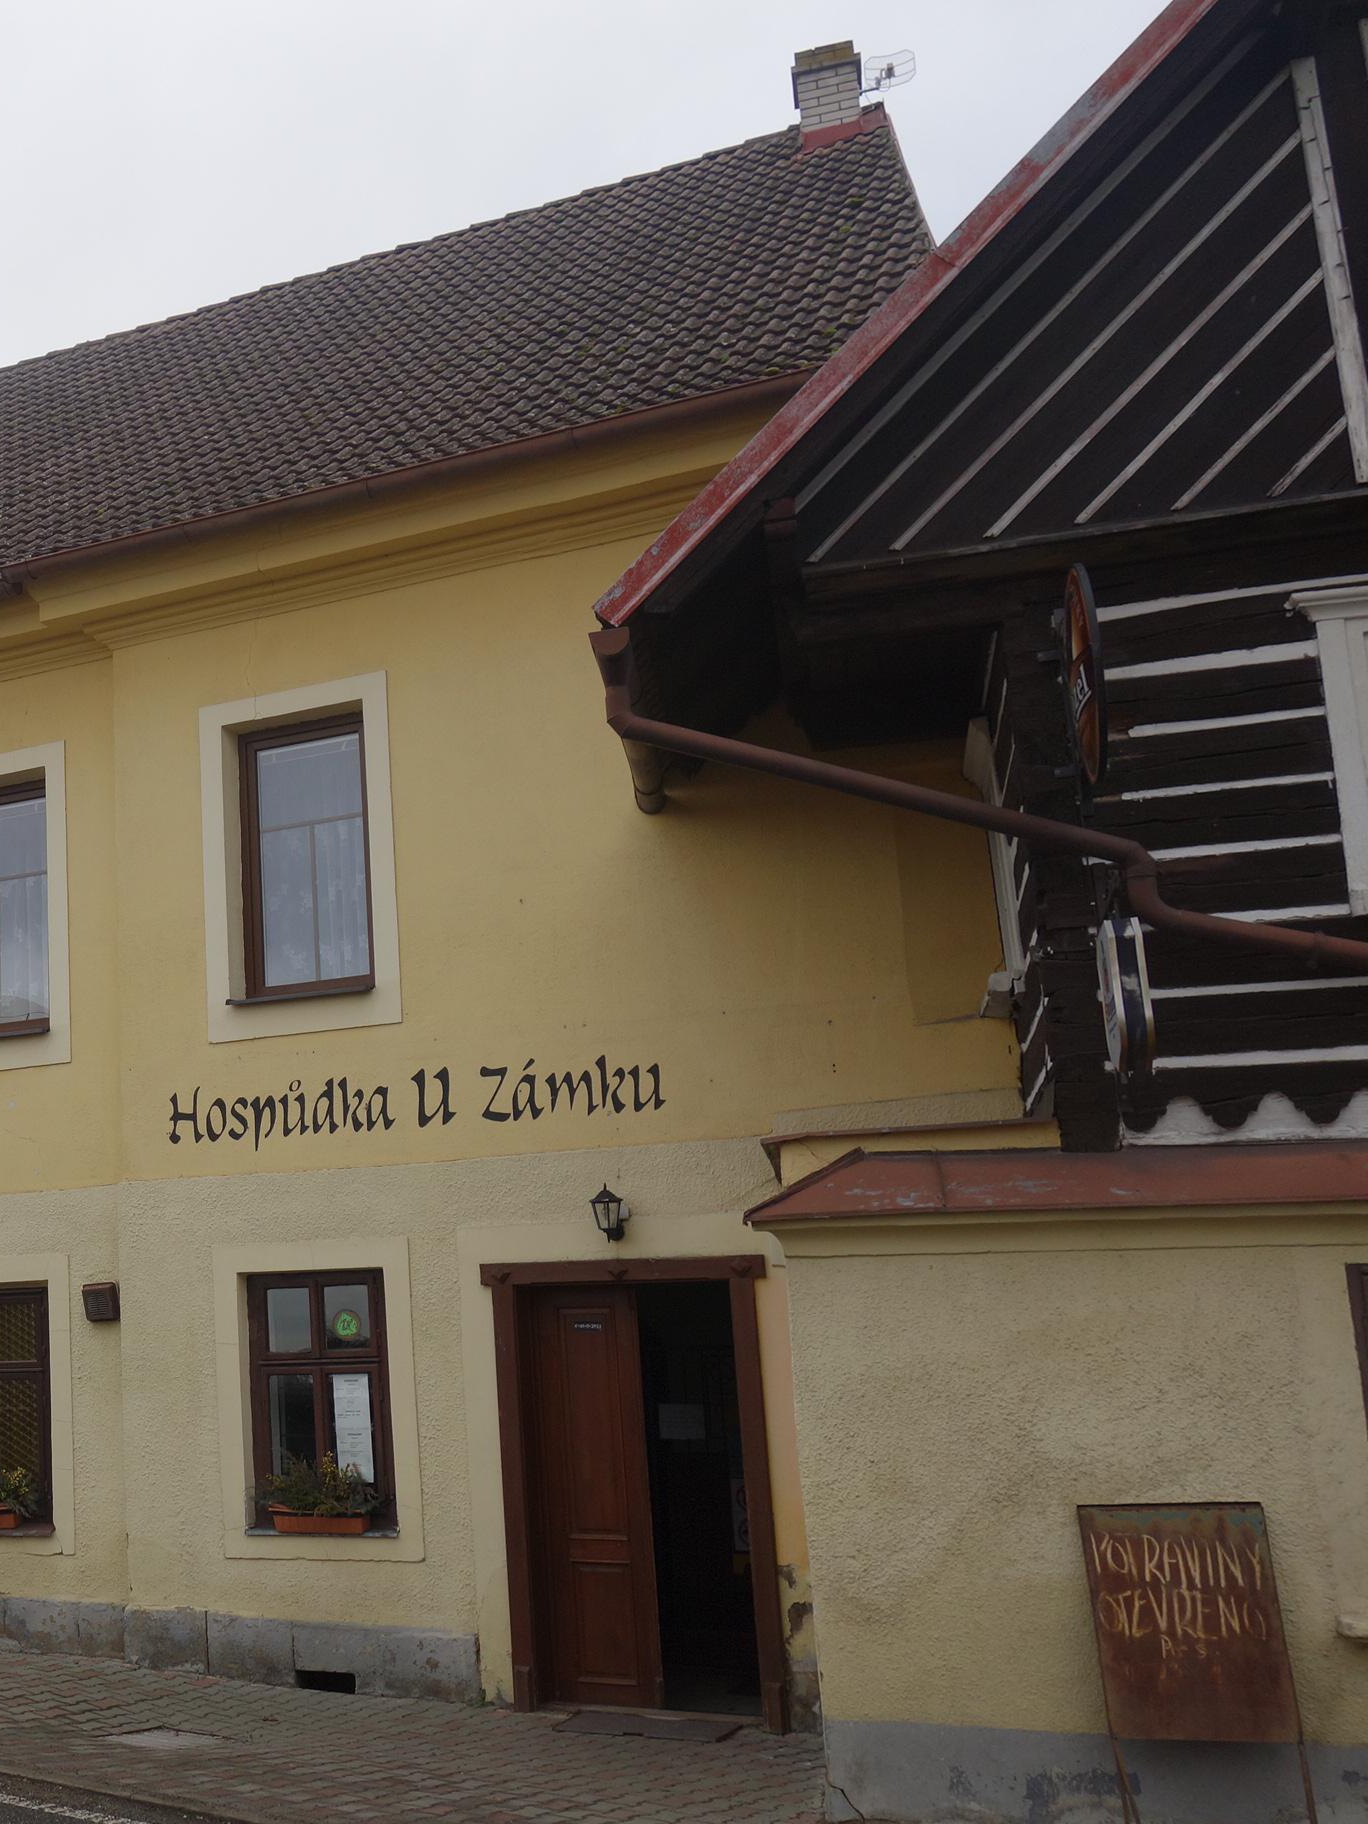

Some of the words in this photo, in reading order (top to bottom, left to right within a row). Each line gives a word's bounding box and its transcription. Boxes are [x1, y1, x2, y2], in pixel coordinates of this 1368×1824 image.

[169, 1076, 396, 1152] Hospůdka
[410, 1066, 457, 1128] U
[479, 1055, 667, 1122] Zámku
[1089, 1532, 1262, 1591] POTRAVINY
